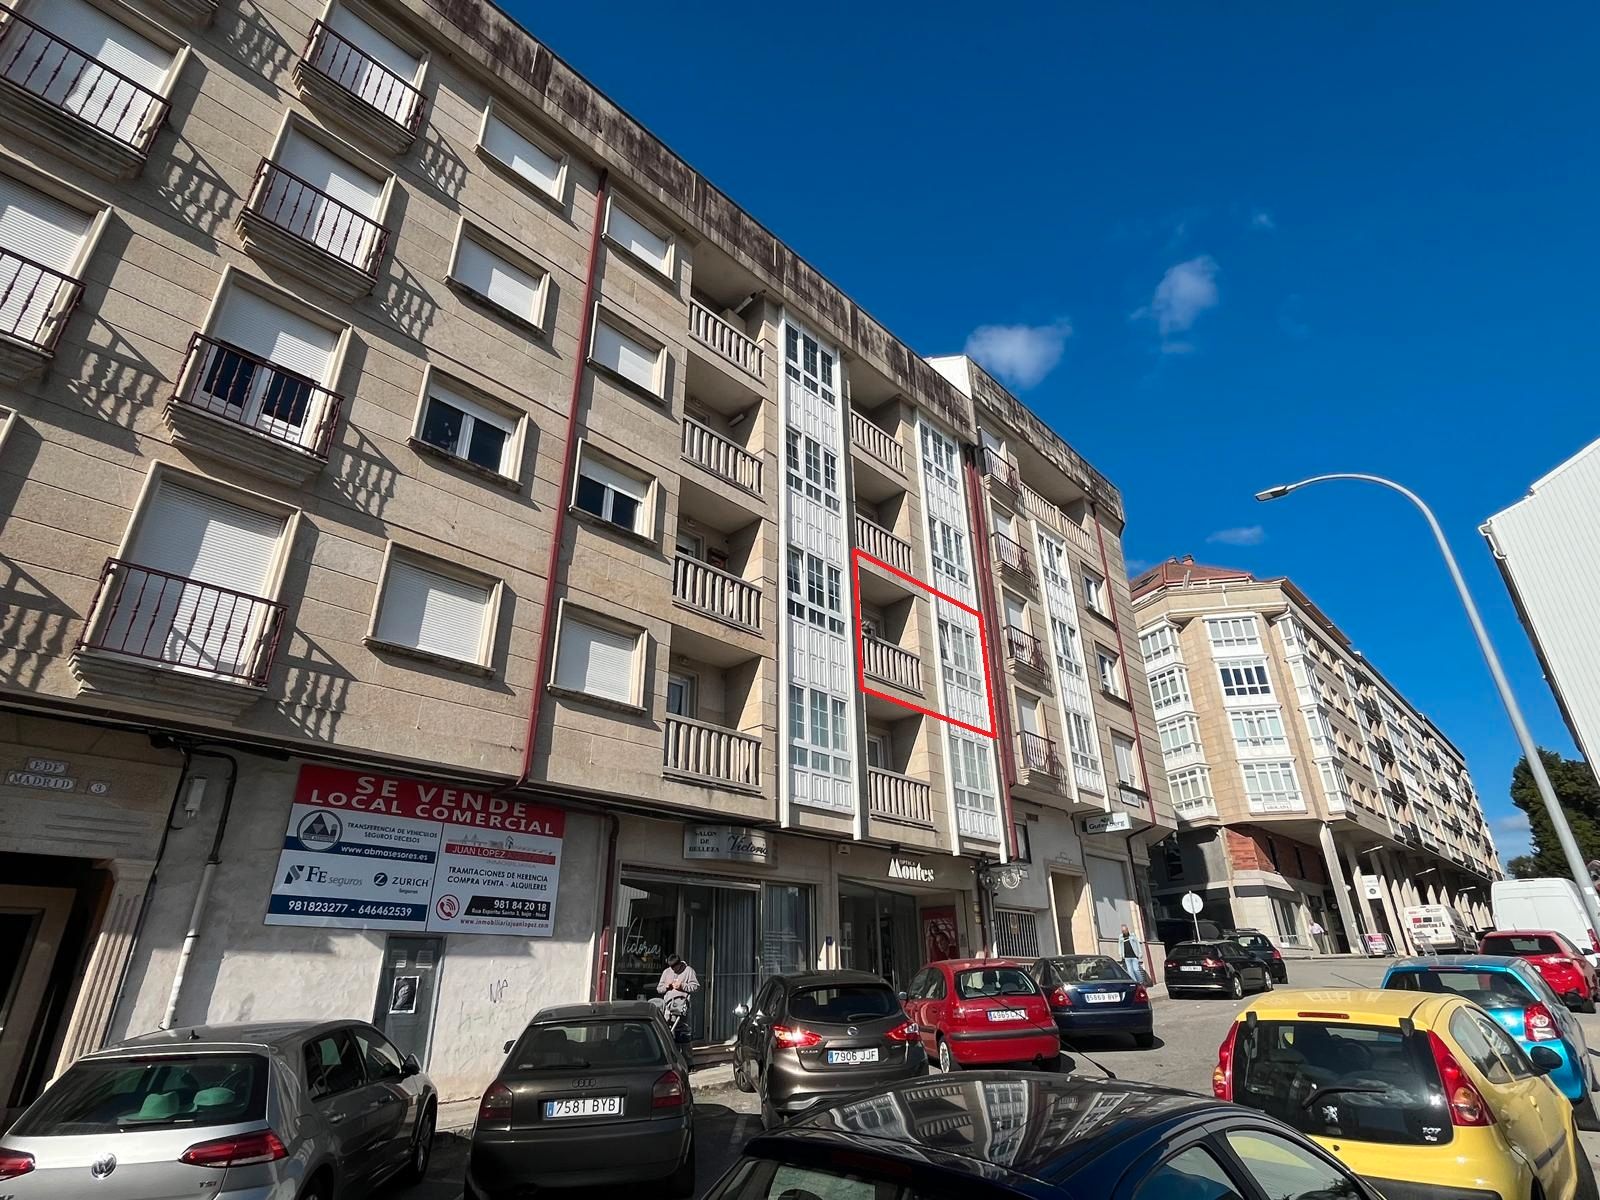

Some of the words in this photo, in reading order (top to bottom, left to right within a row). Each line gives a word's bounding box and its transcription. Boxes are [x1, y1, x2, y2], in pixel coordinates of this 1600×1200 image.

[13, 774, 71, 789] MADRID
[355, 777, 399, 798] SE
[417, 784, 527, 817] VENDE
[310, 789, 402, 814] LOCAL
[415, 804, 554, 835] COMERCIAL
[347, 822, 396, 834] TRANSFERENCIA
[397, 826, 406, 834] DE
[364, 832, 393, 841] SEGUROS
[394, 835, 420, 844] DECESOS
[341, 845, 428, 860] www.abmasesores.es
[452, 845, 476, 856] JUAN
[448, 866, 505, 878] TRAMITACIONES
[506, 871, 515, 879] DE
[516, 872, 548, 883] HERENCIA
[888, 857, 935, 882] Montes
[328, 875, 363, 887] seguros
[392, 876, 429, 888] ZURICH
[447, 875, 480, 885] COMPRA
[482, 878, 504, 887] VENTA
[510, 882, 547, 891] ALQUILERES
[288, 900, 348, 913] 981823277
[358, 904, 412, 917] 646462539
[494, 900, 510, 909] 981
[512, 901, 522, 910] 84
[524, 902, 535, 911] 20
[537, 903, 547, 912] 18
[834, 1051, 857, 1062] 7906
[860, 1050, 877, 1061] JJF
[556, 1100, 586, 1114] 7581
[592, 1098, 616, 1112] BYB
